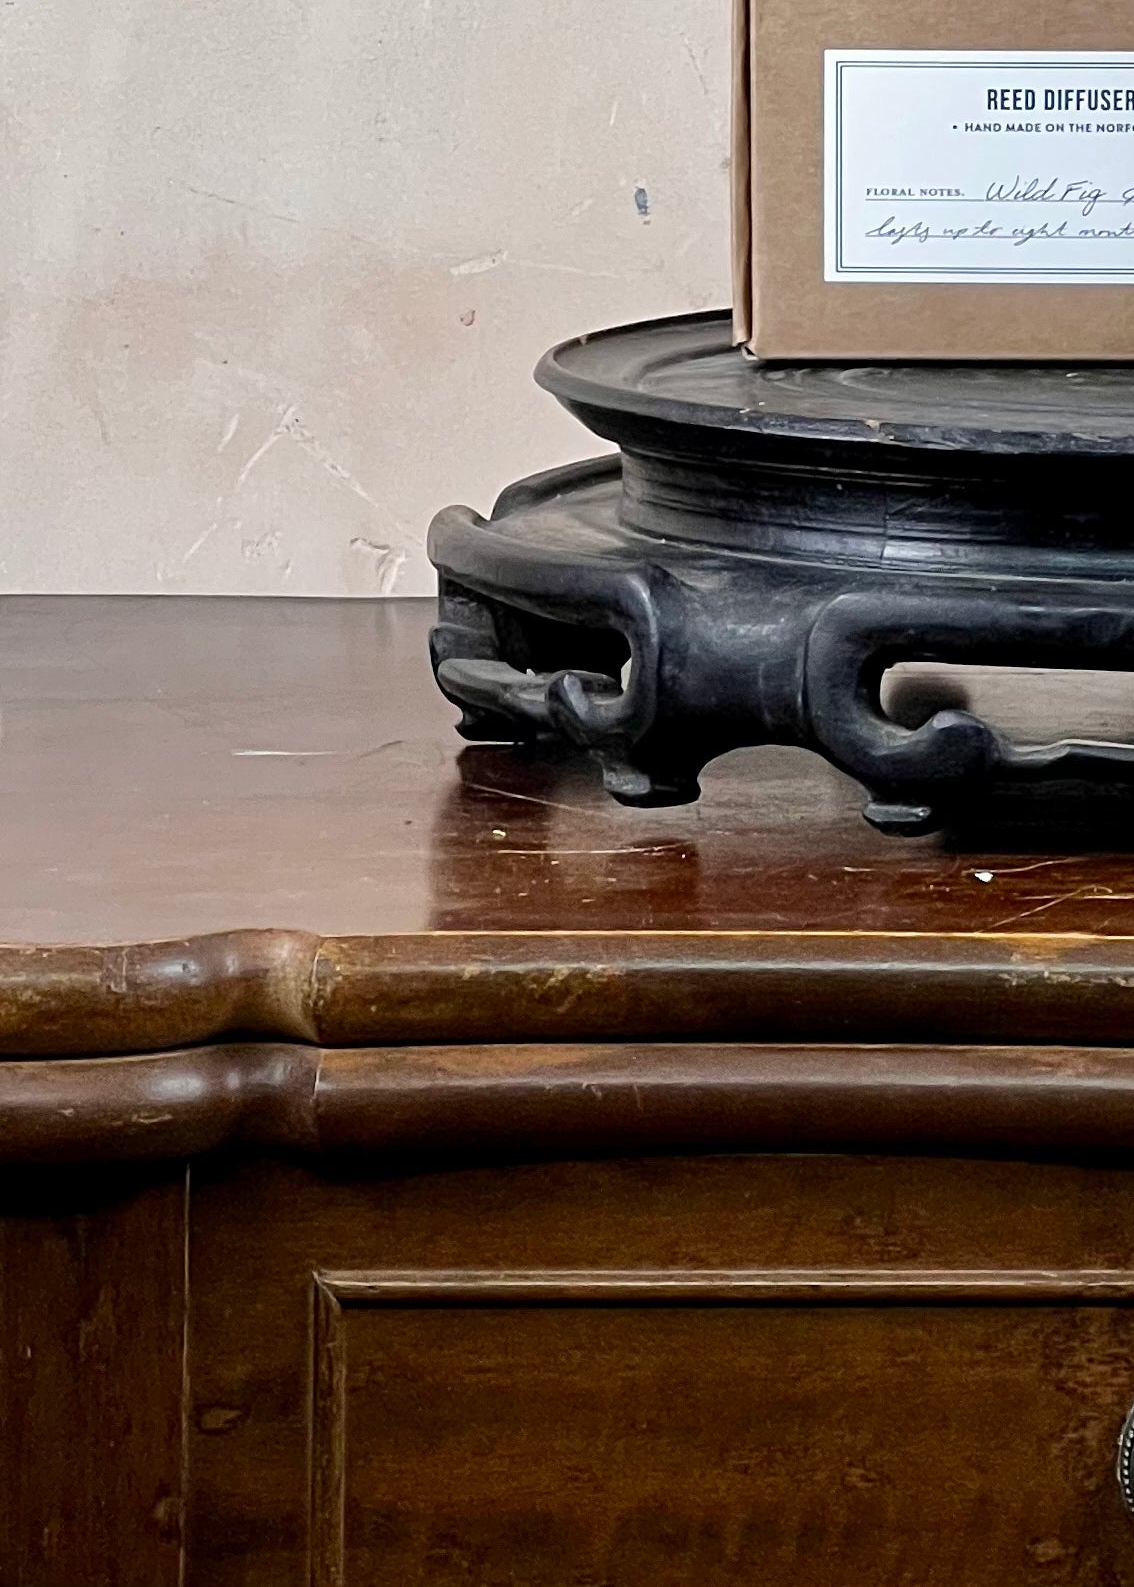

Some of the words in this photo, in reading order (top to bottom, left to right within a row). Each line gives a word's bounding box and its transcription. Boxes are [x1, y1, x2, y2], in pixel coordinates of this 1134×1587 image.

[987, 89, 1036, 110] REED
[964, 122, 1001, 132] HAND
[1005, 123, 1042, 133] MADE
[1045, 123, 1064, 133] ON
[1069, 123, 1092, 133] THE
[866, 188, 915, 196] FLORAL
[919, 188, 965, 197] NOTES.
[985, 175, 1058, 202] Wild
[1060, 180, 1106, 216] Fig
